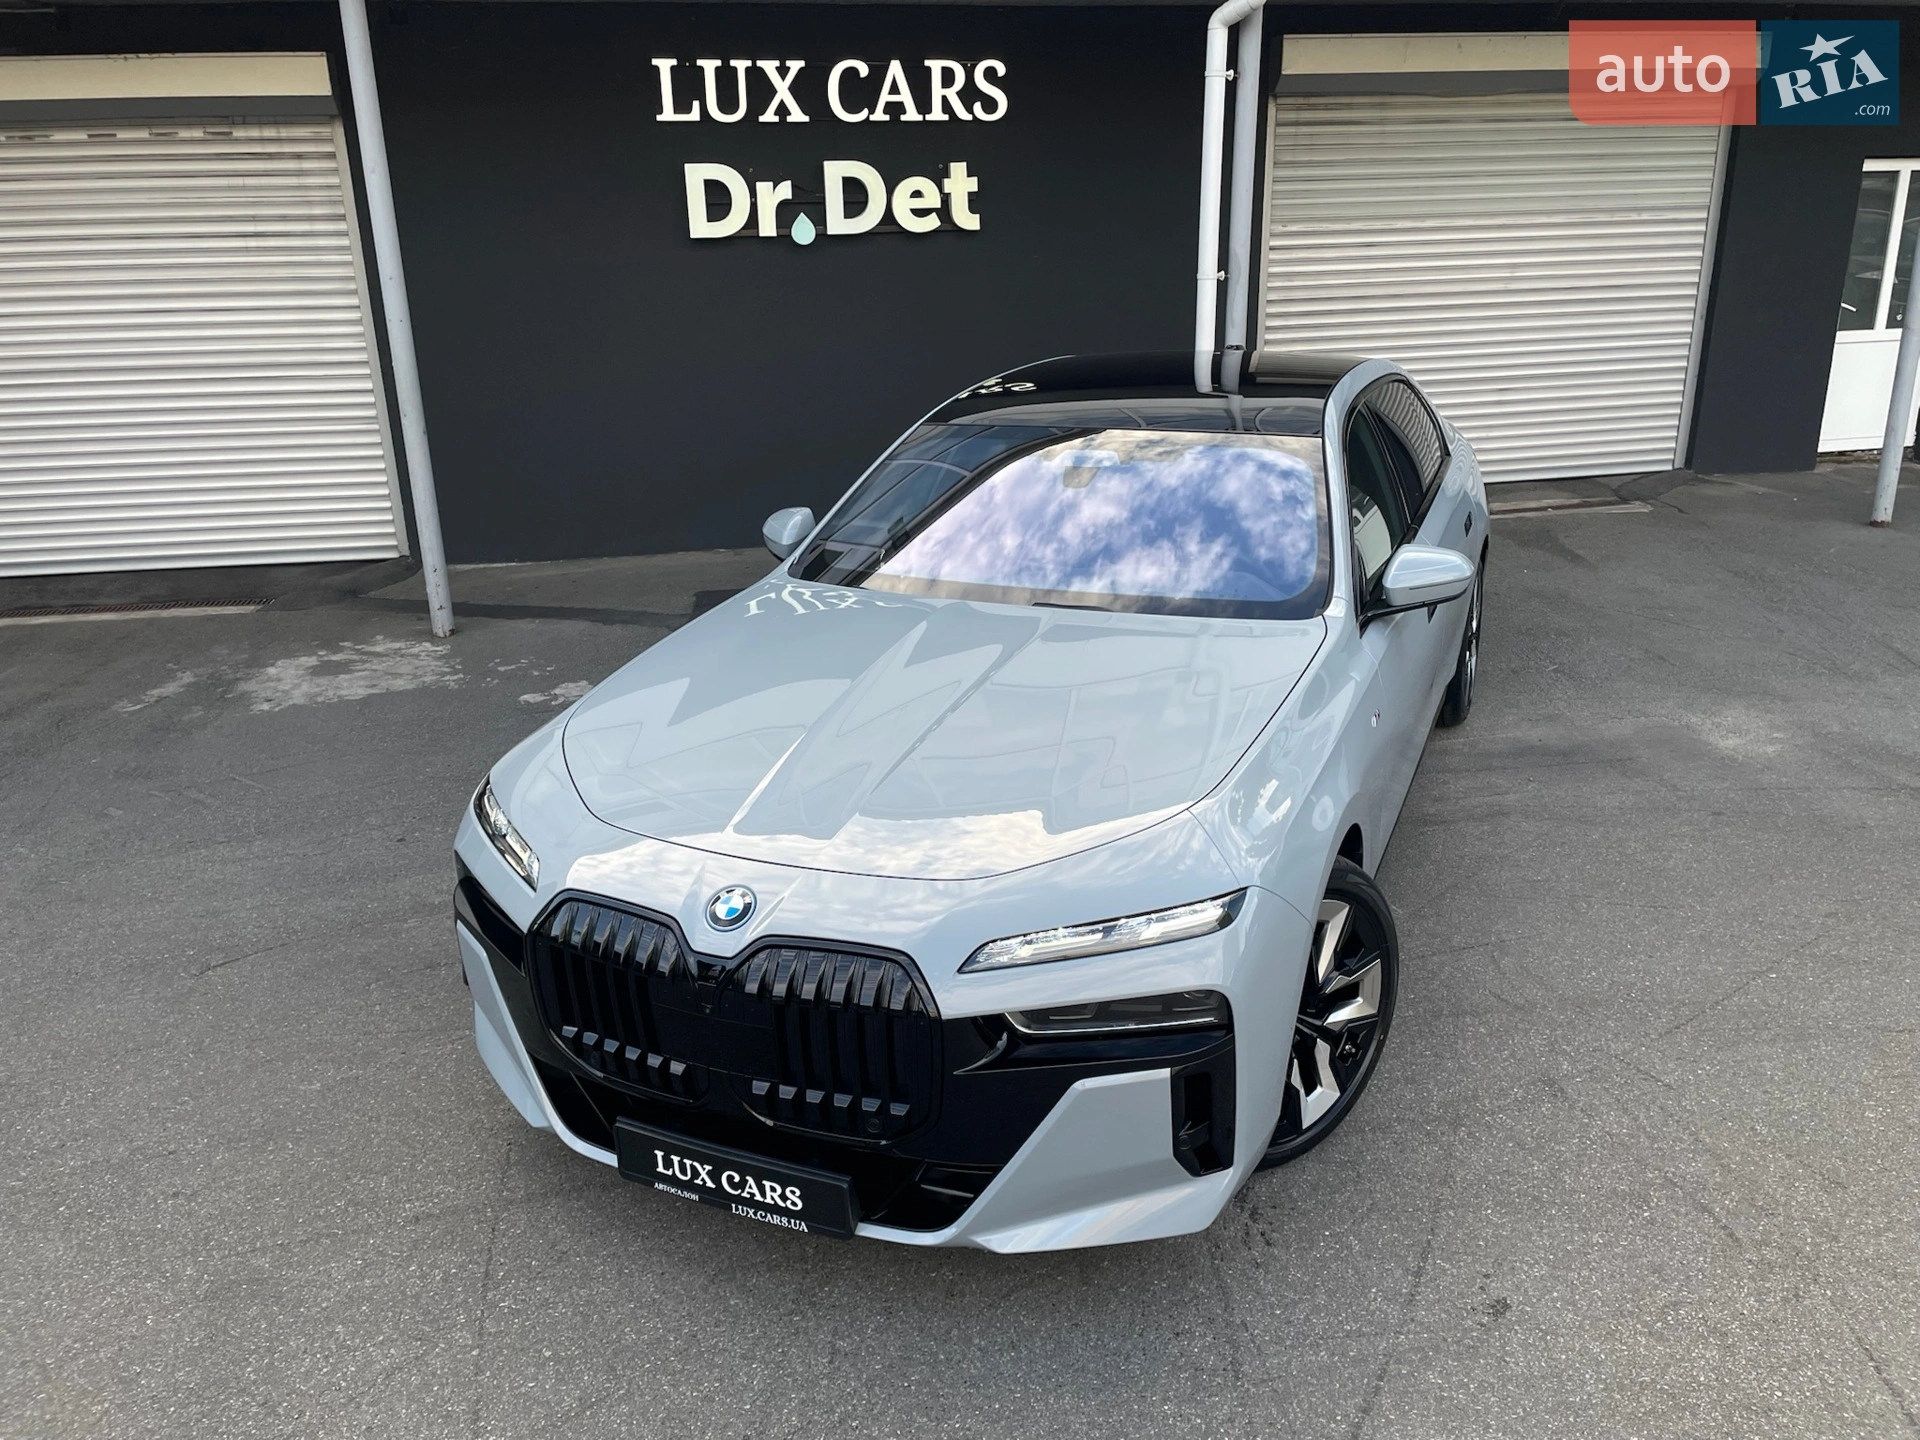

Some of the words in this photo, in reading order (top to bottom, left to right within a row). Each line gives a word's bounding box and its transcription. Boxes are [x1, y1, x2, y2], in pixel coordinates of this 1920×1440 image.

[651, 57, 810, 123] LUX
[827, 58, 1009, 123] CARS
[653, 1149, 716, 1189] LUX
[721, 1170, 804, 1212] CARS
[653, 1181, 700, 1202] АВТОСАЛОН
[731, 1203, 809, 1233] LUX.CARS.UA
